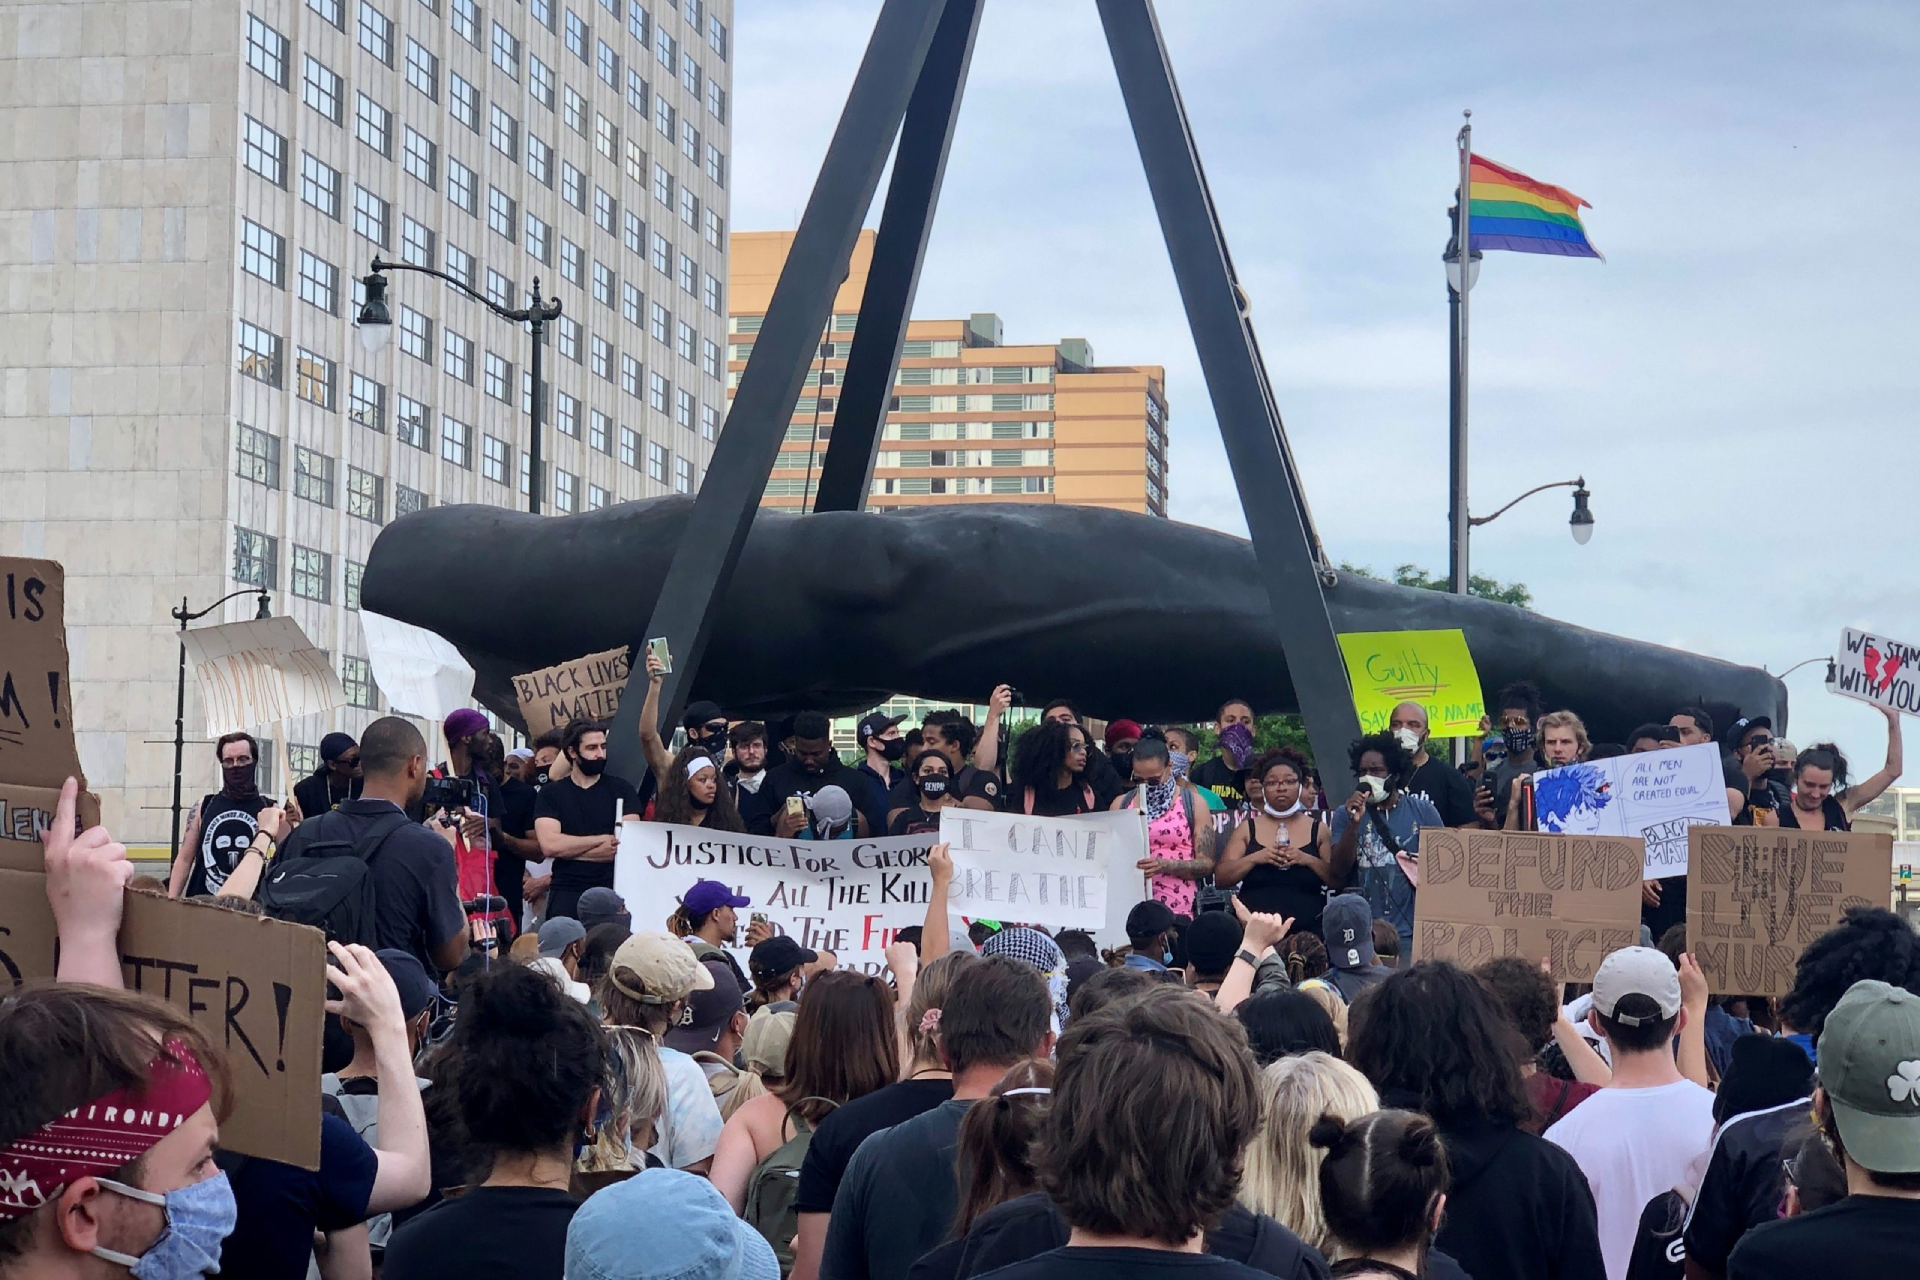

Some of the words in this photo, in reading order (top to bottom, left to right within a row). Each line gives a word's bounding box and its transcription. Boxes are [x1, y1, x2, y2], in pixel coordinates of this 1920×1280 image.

[7, 572, 46, 622] IS
[1847, 631, 1875, 659] WE
[518, 667, 583, 703] BLACK
[587, 654, 631, 687] LIVES
[1365, 649, 1438, 697] Guilty
[1840, 664, 1881, 699] WITH
[1887, 677, 1920, 712] YOU
[1361, 708, 1389, 731] SAY
[1632, 776, 1648, 786] ARE
[1654, 774, 1677, 786] NOT
[1636, 763, 1652, 773] ALL
[1659, 759, 1682, 770] MEN
[1633, 789, 1672, 801] CREATED
[0, 800, 83, 843] LEN
[851, 843, 934, 870] GEOR
[1426, 832, 1640, 892] DEFUND
[1701, 834, 1848, 893] BLUE
[820, 876, 870, 911] THE
[879, 872, 932, 904] KILL
[1488, 891, 1553, 918] THE
[793, 915, 849, 951] THE
[1695, 941, 1797, 993] MUR
